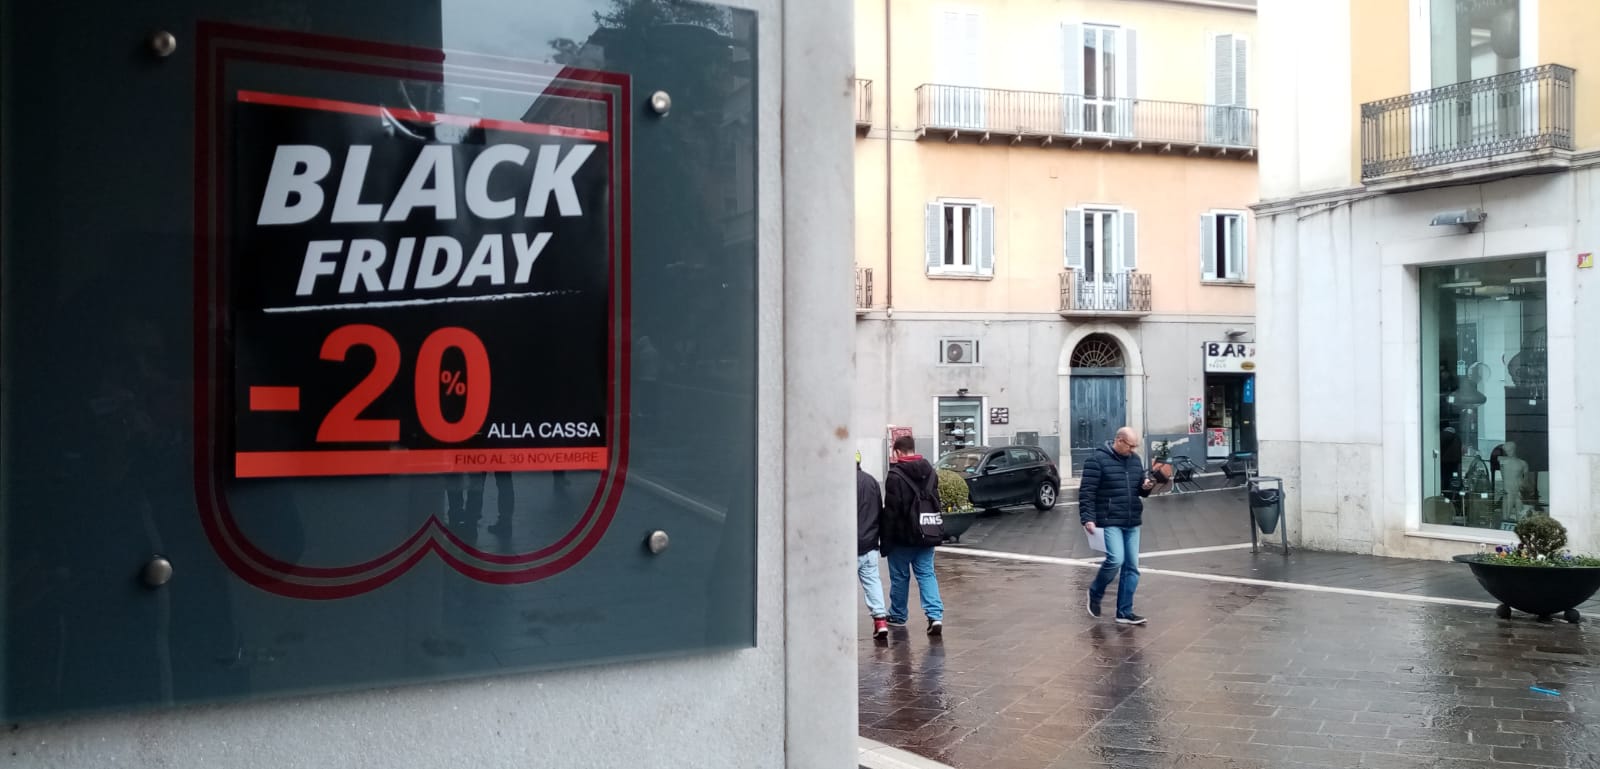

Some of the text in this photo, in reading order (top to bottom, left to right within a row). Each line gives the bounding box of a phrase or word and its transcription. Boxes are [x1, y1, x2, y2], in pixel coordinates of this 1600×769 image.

[257, 143, 596, 225] BLACK
[295, 231, 553, 296] FRIDAY
[1208, 343, 1246, 358] BAR
[487, 421, 601, 439] ALLA CASSA
[454, 451, 600, 466] FINO AL 30 NOVEMBRE
